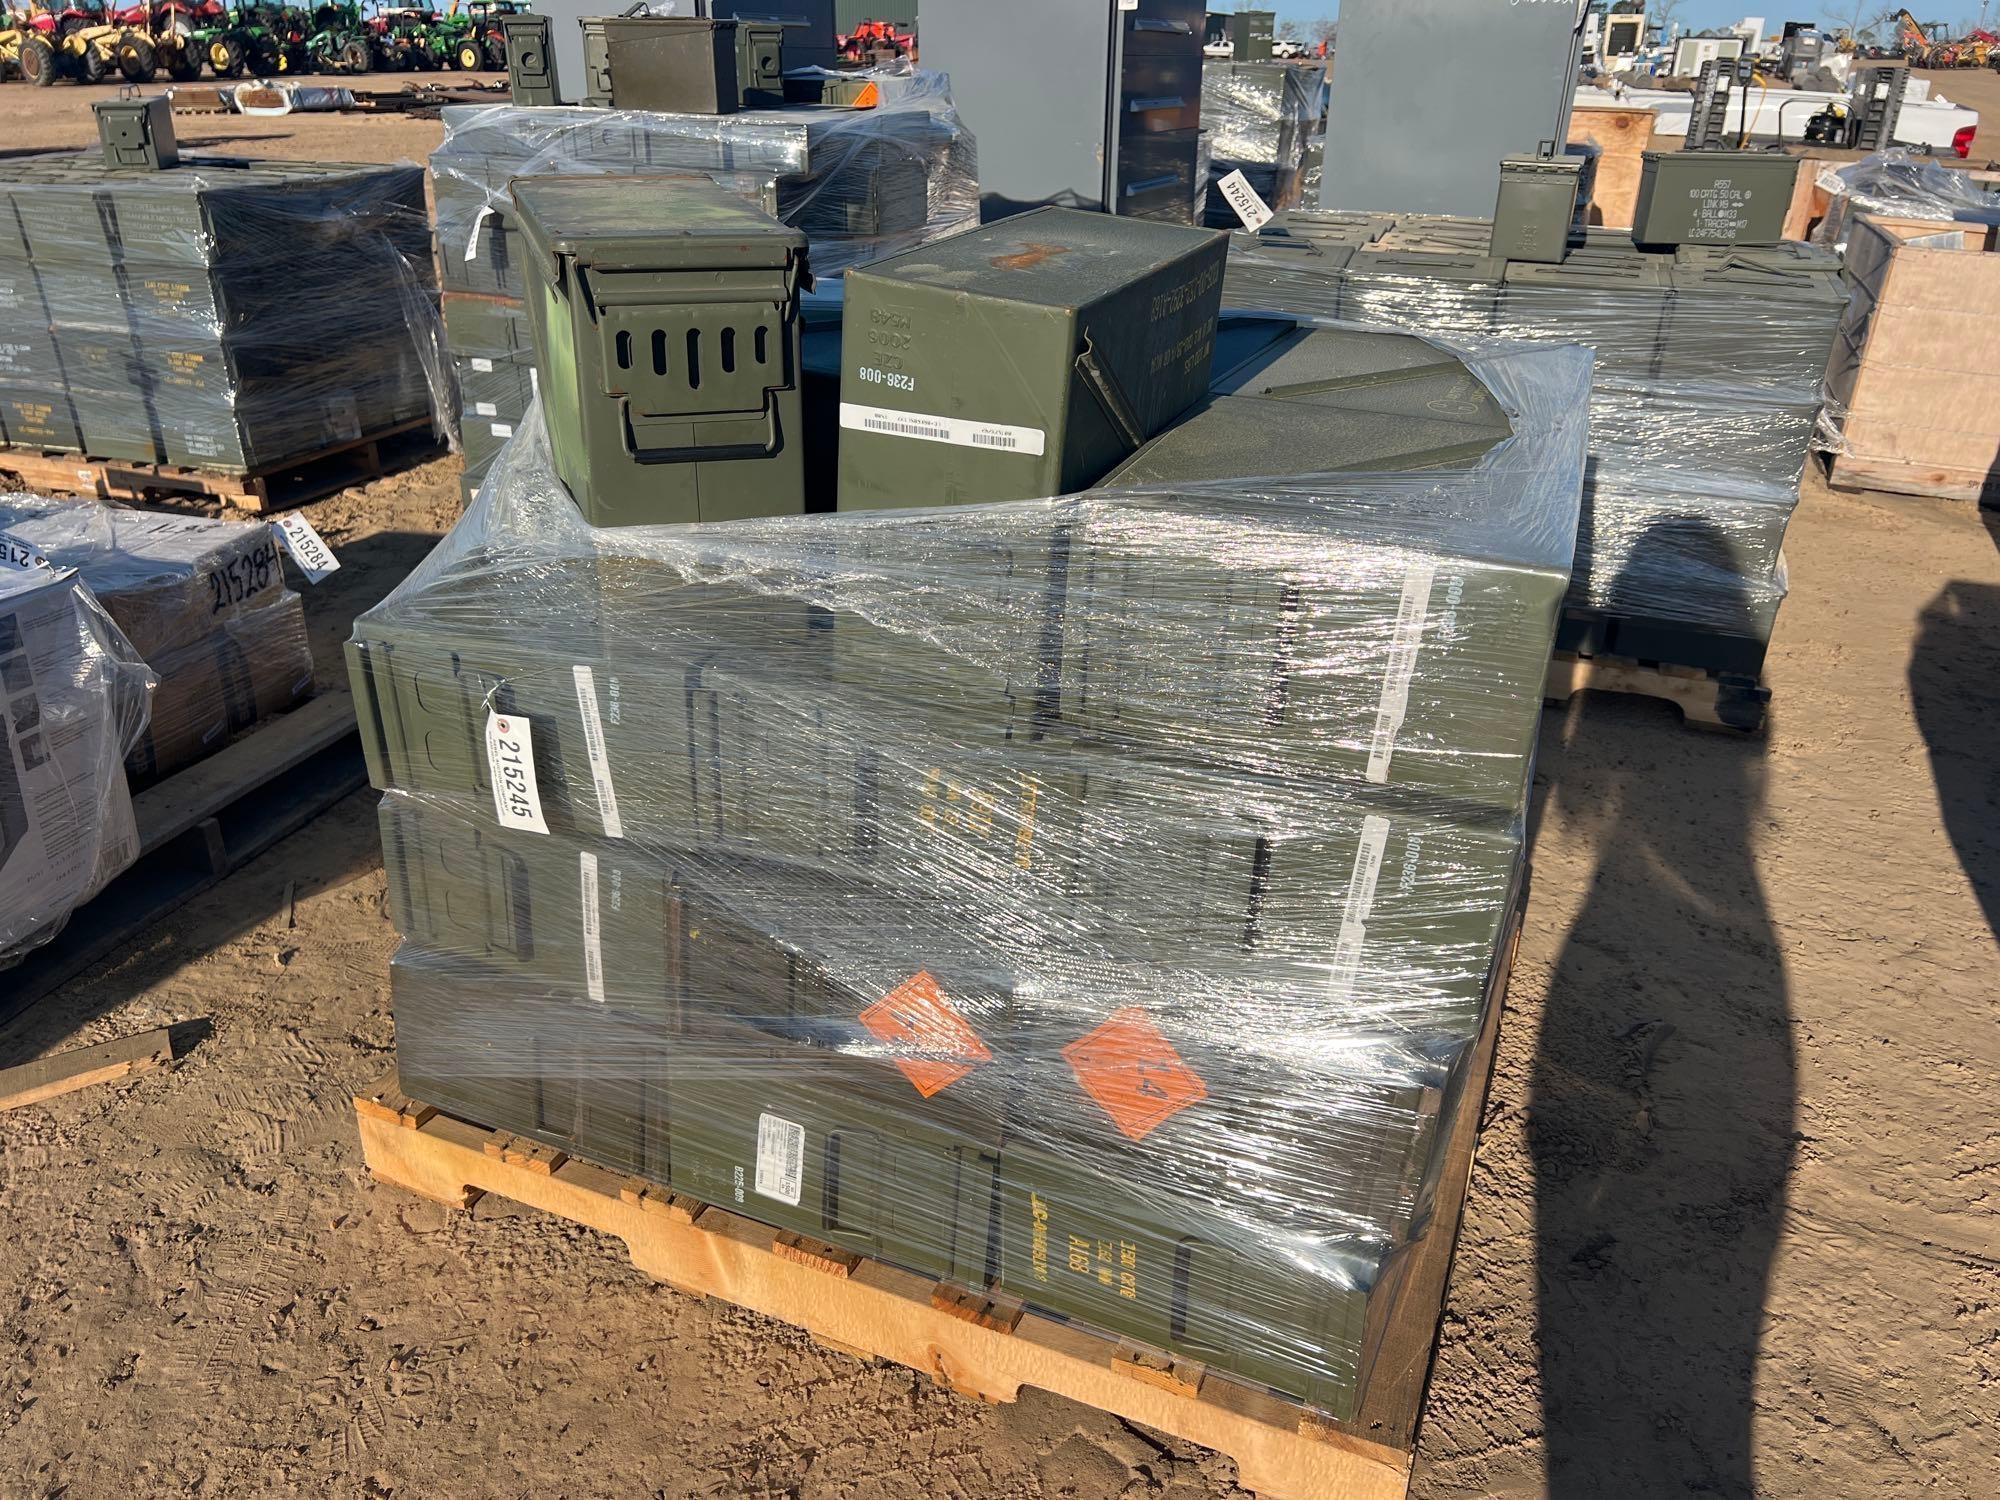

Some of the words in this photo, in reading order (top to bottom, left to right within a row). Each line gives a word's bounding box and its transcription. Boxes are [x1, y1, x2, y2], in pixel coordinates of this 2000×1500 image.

[1227, 182, 1257, 218] 215244
[1703, 199, 1718, 209] LINK
[858, 366, 915, 392] F236-008
[289, 527, 328, 571] 215284
[498, 739, 533, 818] 215245
[734, 1165, 745, 1203] B225-009
[1068, 1234, 1090, 1275] A168
